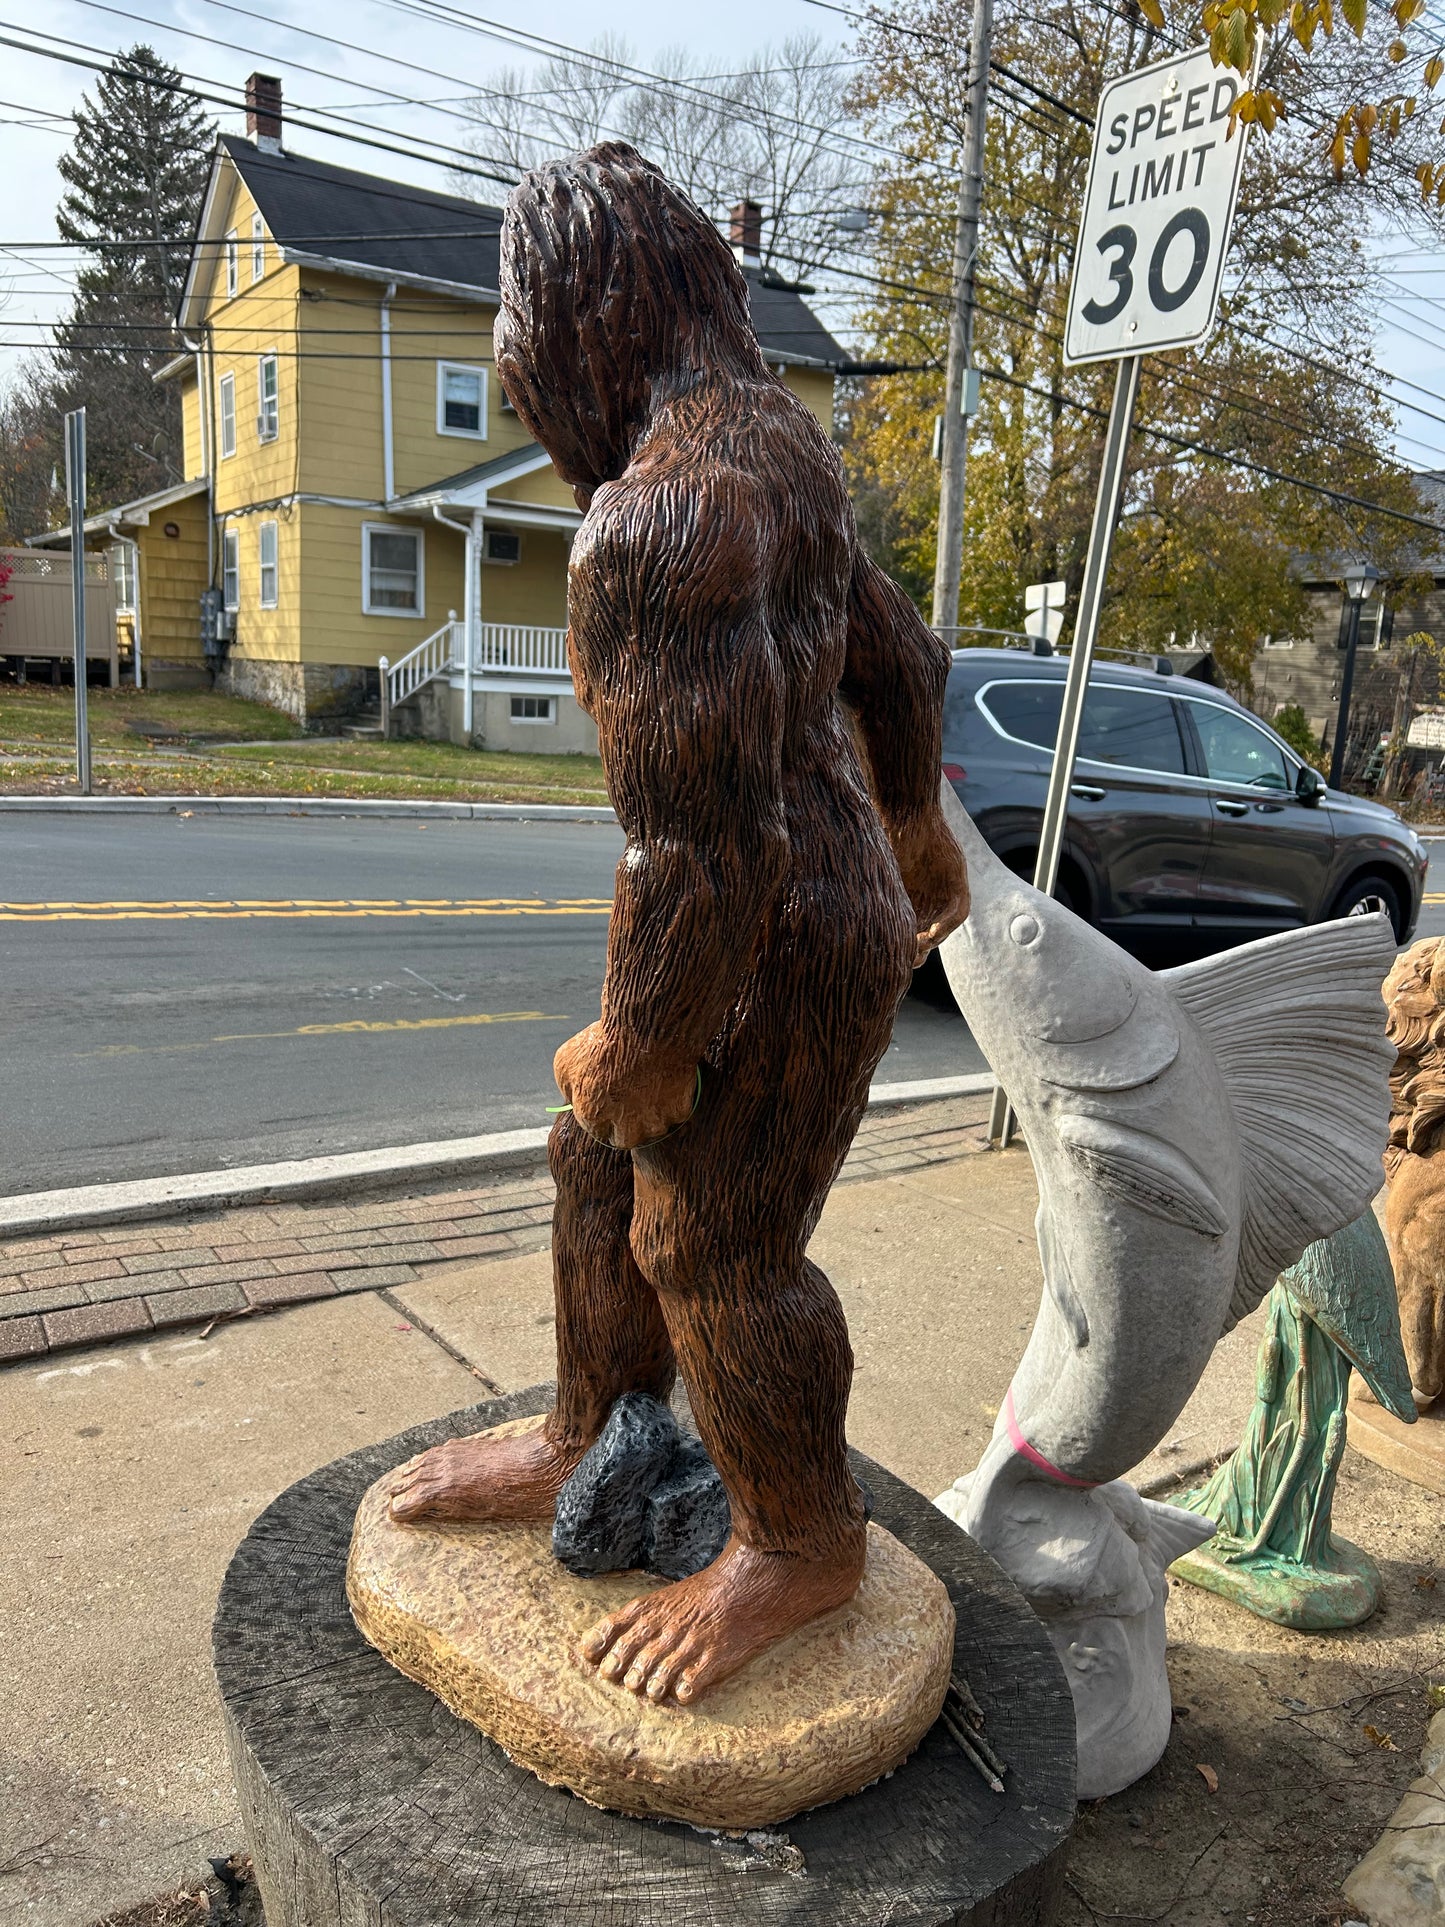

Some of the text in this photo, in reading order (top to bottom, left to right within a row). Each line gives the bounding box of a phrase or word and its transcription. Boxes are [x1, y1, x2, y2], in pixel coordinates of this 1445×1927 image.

[1106, 77, 1238, 155] SPEED
[1108, 141, 1216, 211] LIMIT
[1081, 206, 1210, 325] 30
